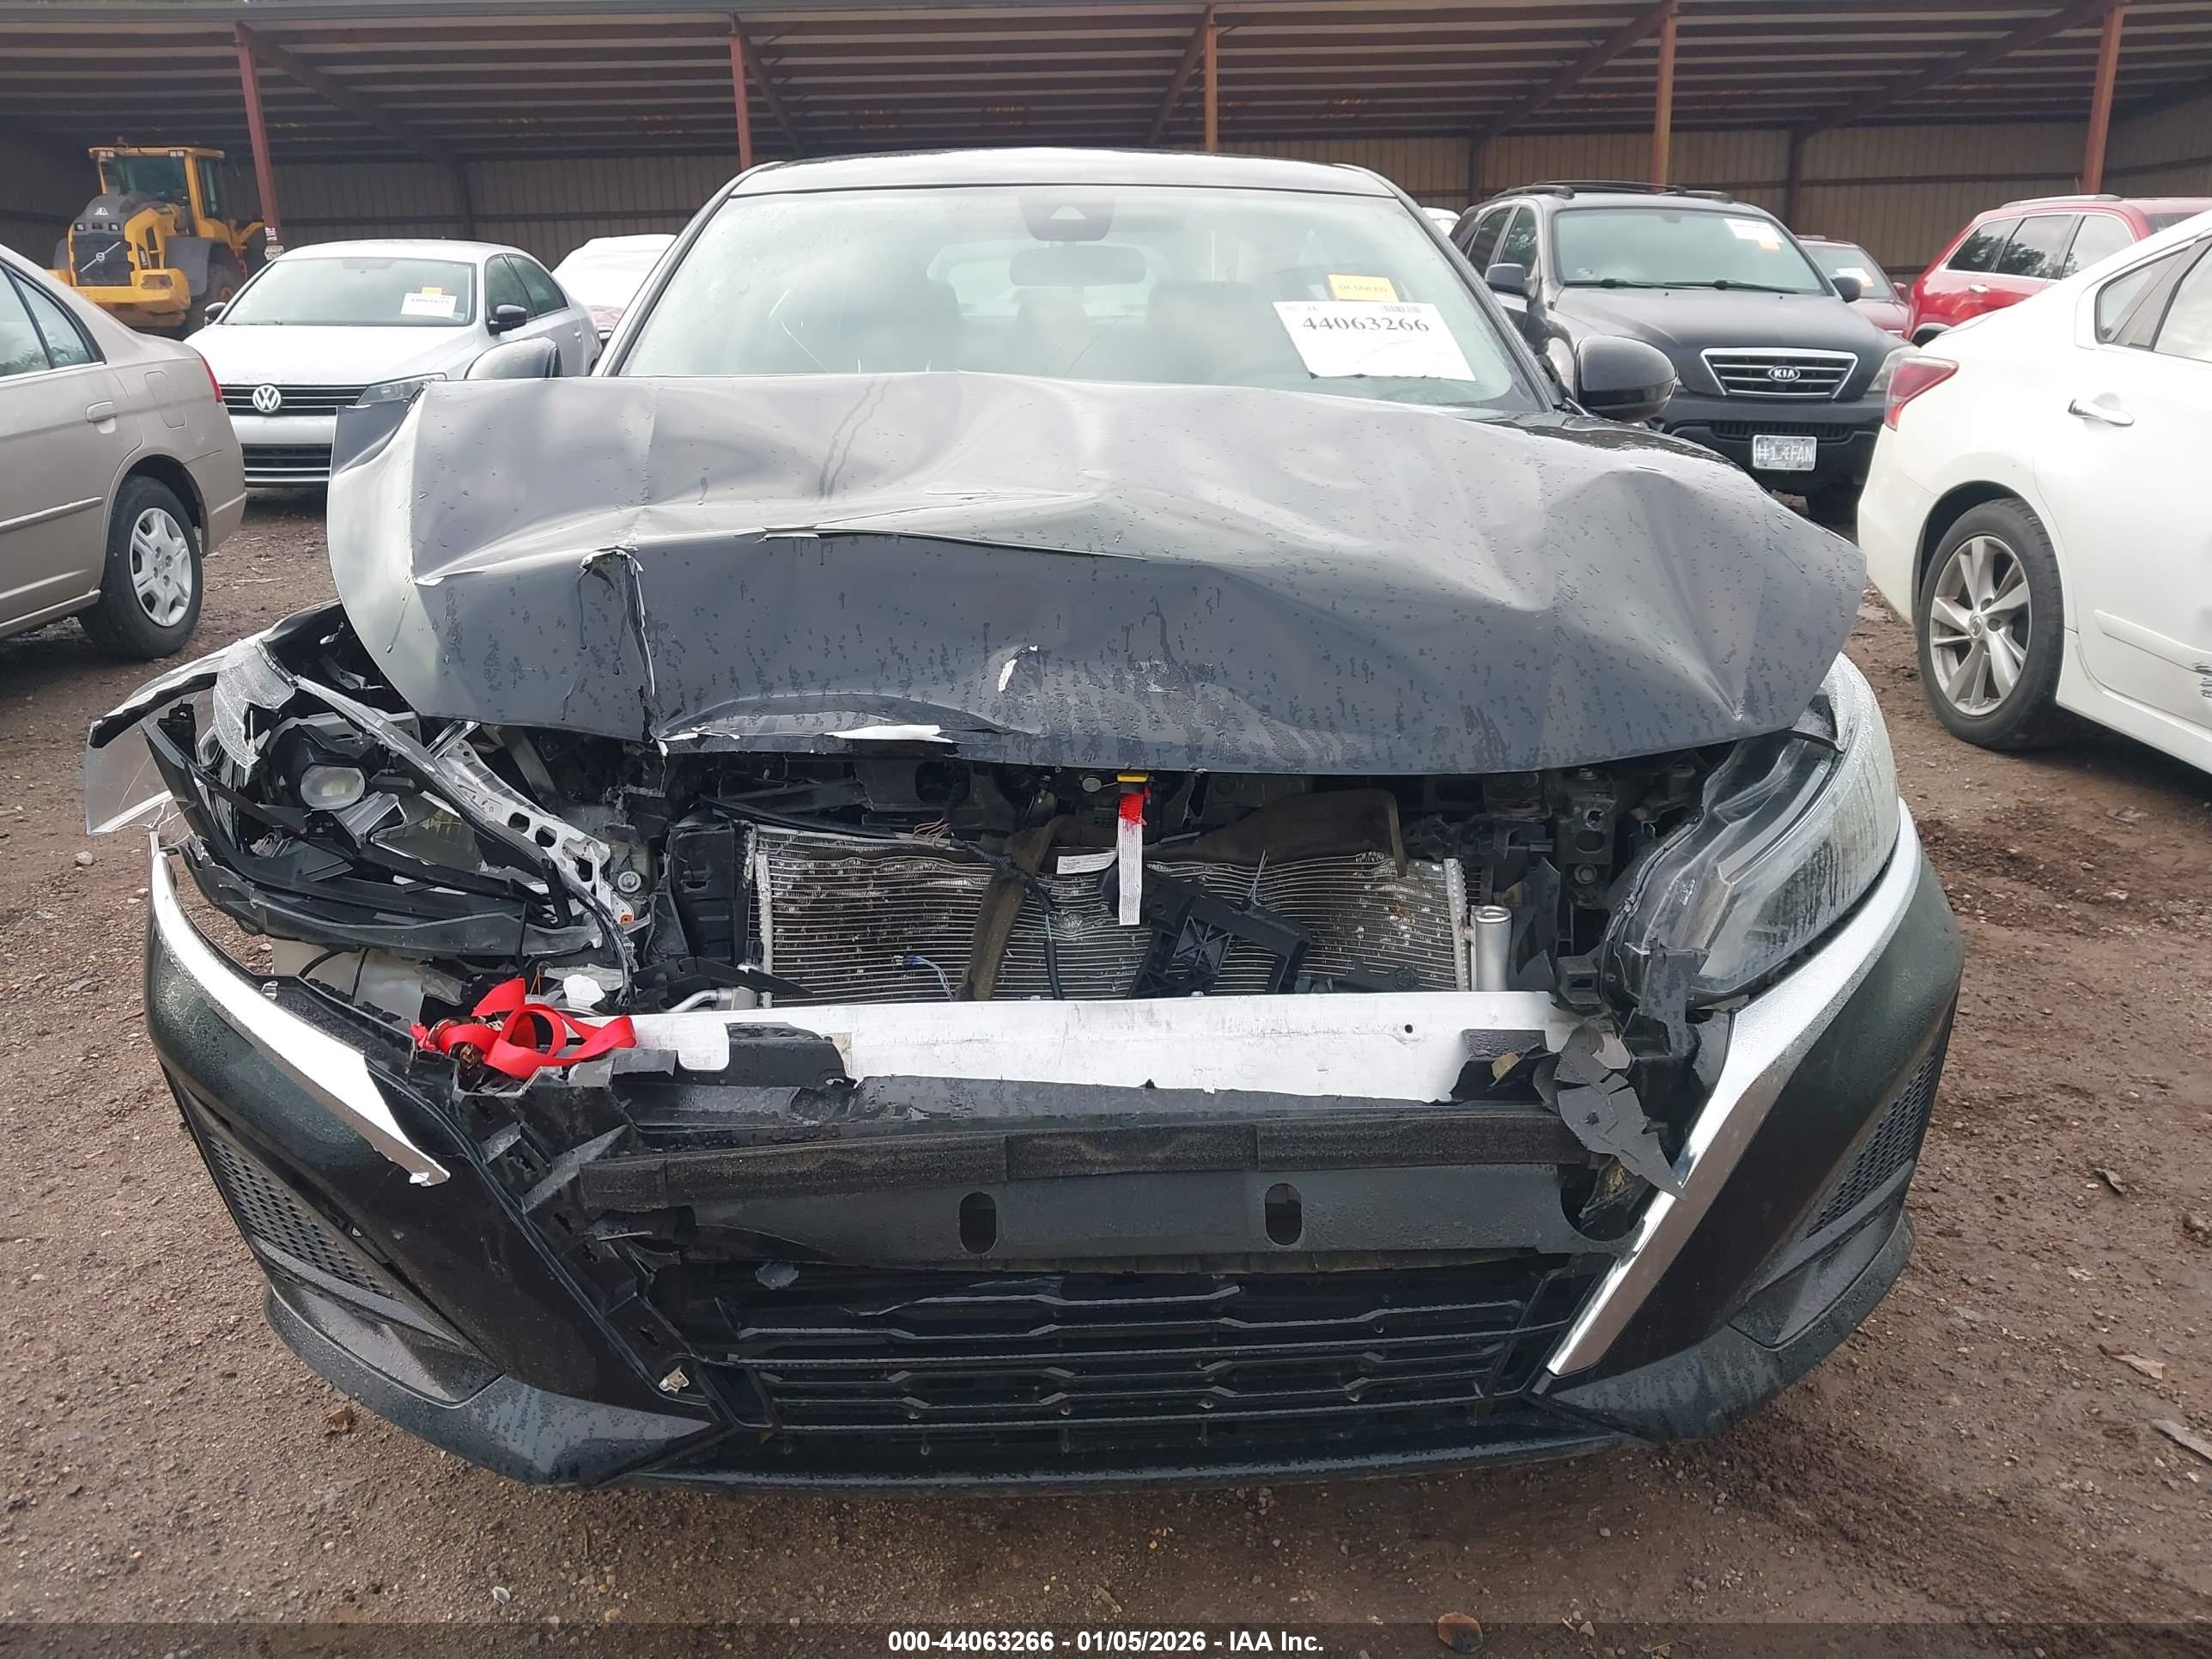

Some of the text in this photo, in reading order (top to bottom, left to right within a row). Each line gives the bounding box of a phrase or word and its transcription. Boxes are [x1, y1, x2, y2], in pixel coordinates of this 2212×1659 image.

[1303, 316, 1430, 332] 44063266
[1774, 368, 1795, 379] KIA
[1790, 445, 1814, 463] FAN
